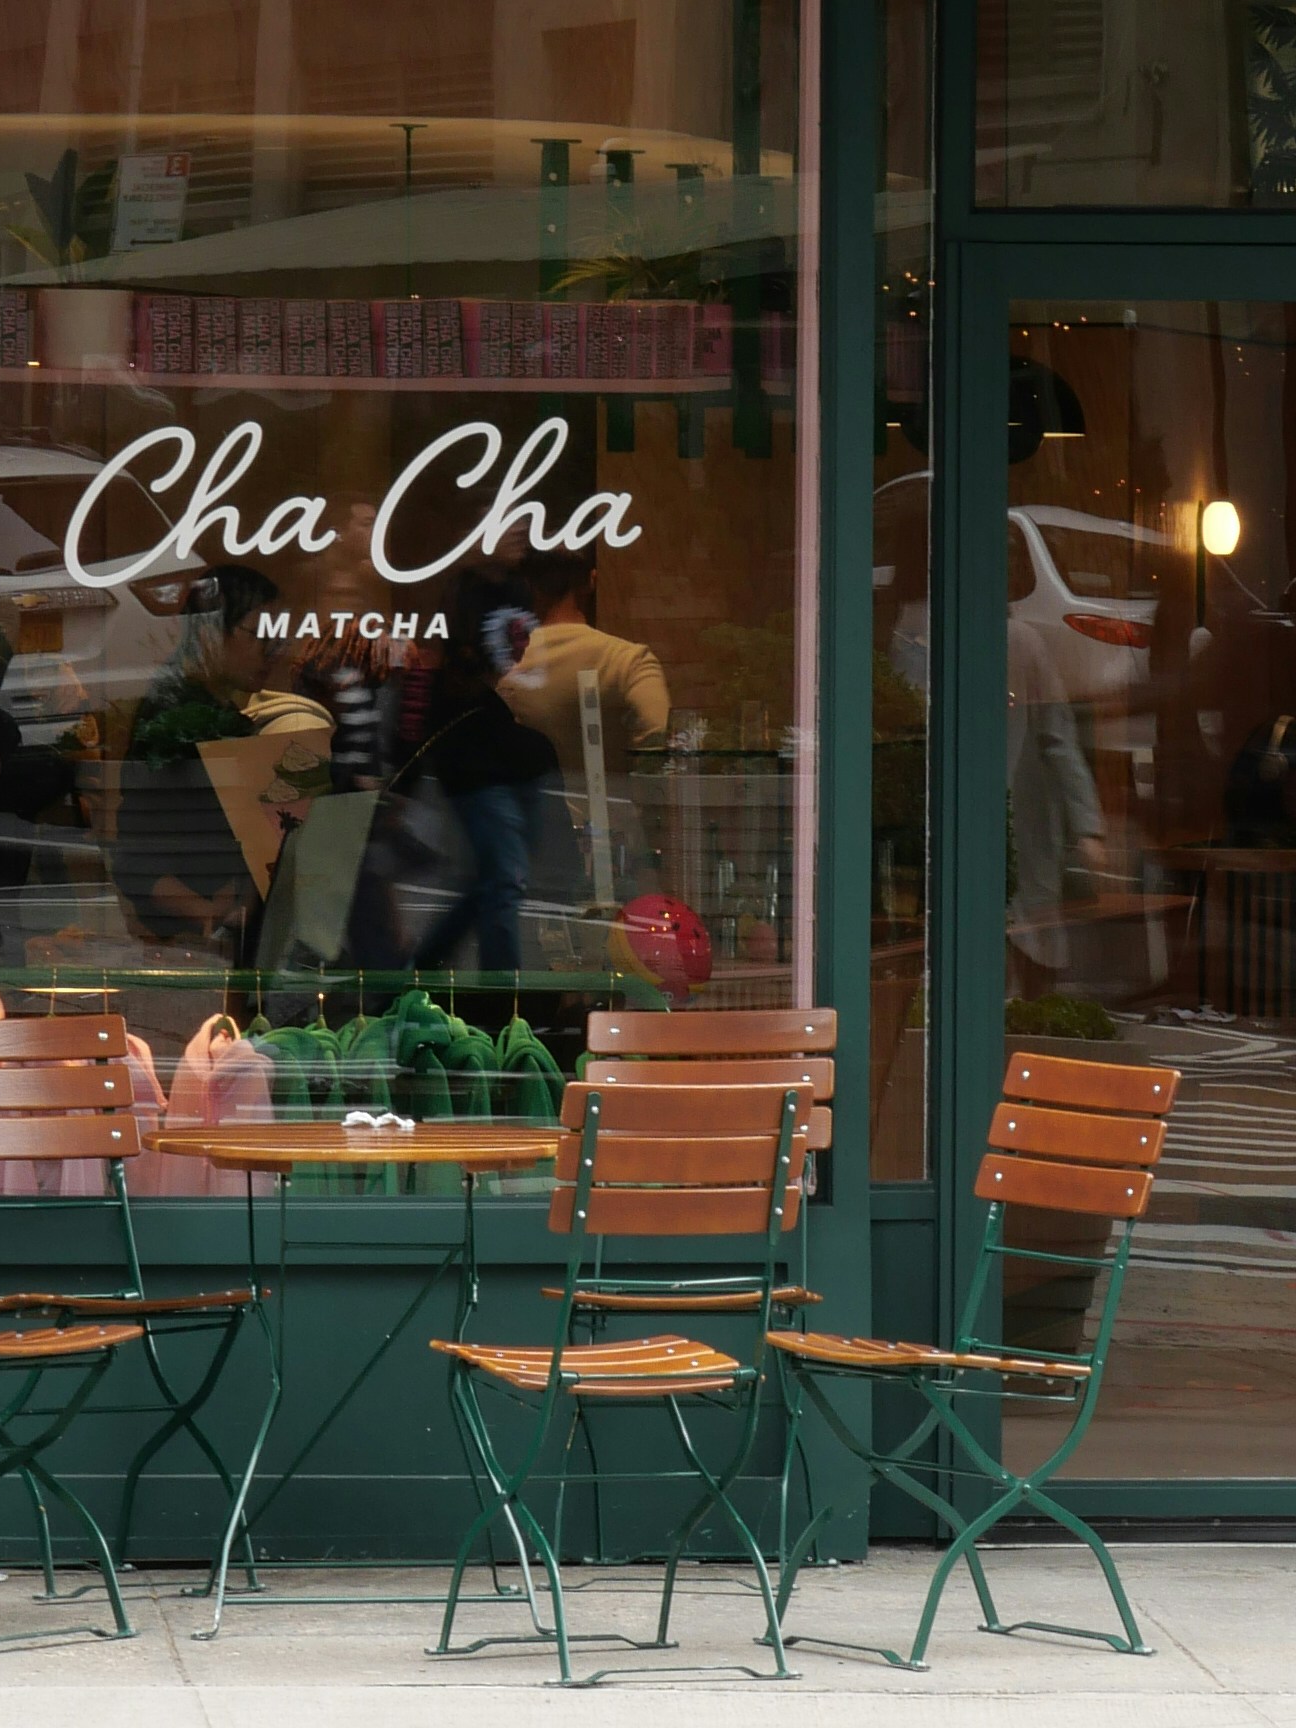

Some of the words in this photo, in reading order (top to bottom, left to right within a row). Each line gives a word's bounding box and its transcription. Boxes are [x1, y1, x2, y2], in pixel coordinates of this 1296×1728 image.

[4, 308, 16, 334] CHA
[154, 313, 166, 370] MATCHA
[4, 339, 16, 365] CHA
[386, 317, 398, 375] MATCHA
[63, 421, 337, 588] Cha
[370, 417, 642, 583] Cha
[257, 612, 449, 639] MATCHA
